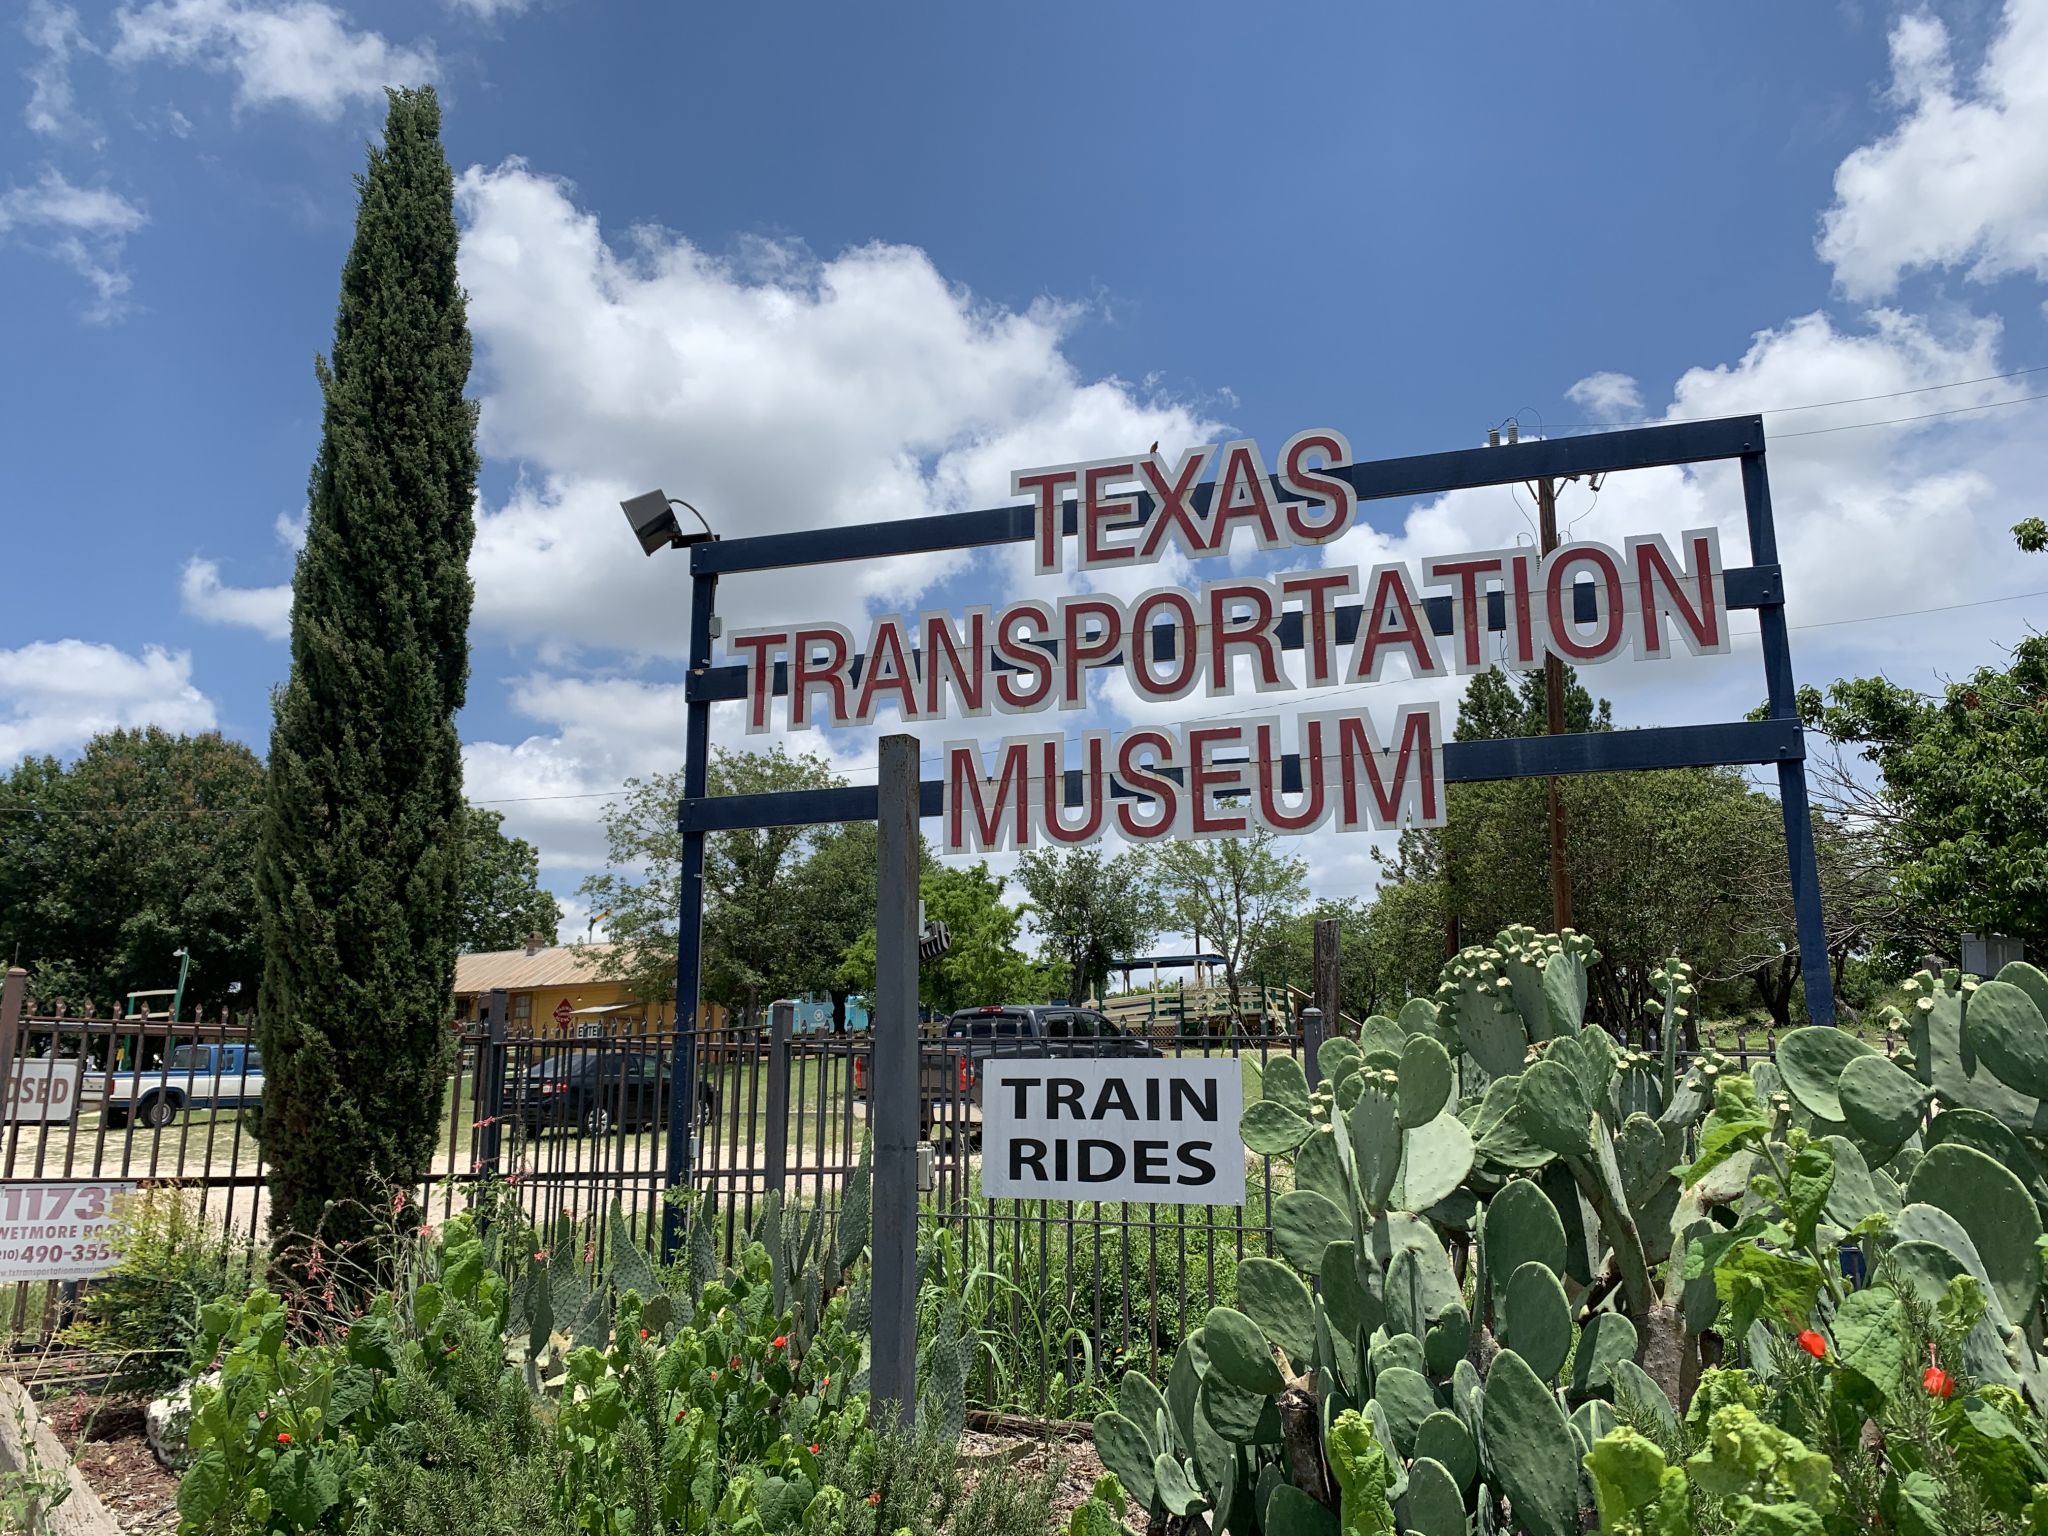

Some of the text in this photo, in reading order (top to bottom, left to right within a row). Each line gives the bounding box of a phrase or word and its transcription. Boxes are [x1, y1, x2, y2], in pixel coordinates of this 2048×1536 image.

[1016, 434, 1350, 569] TEXAS
[731, 535, 1722, 729] TRANSPORTATION
[948, 710, 1439, 850] MUSEUM
[1001, 1077, 1218, 1122] TRAIN
[1009, 1138, 1216, 1186] RIDES
